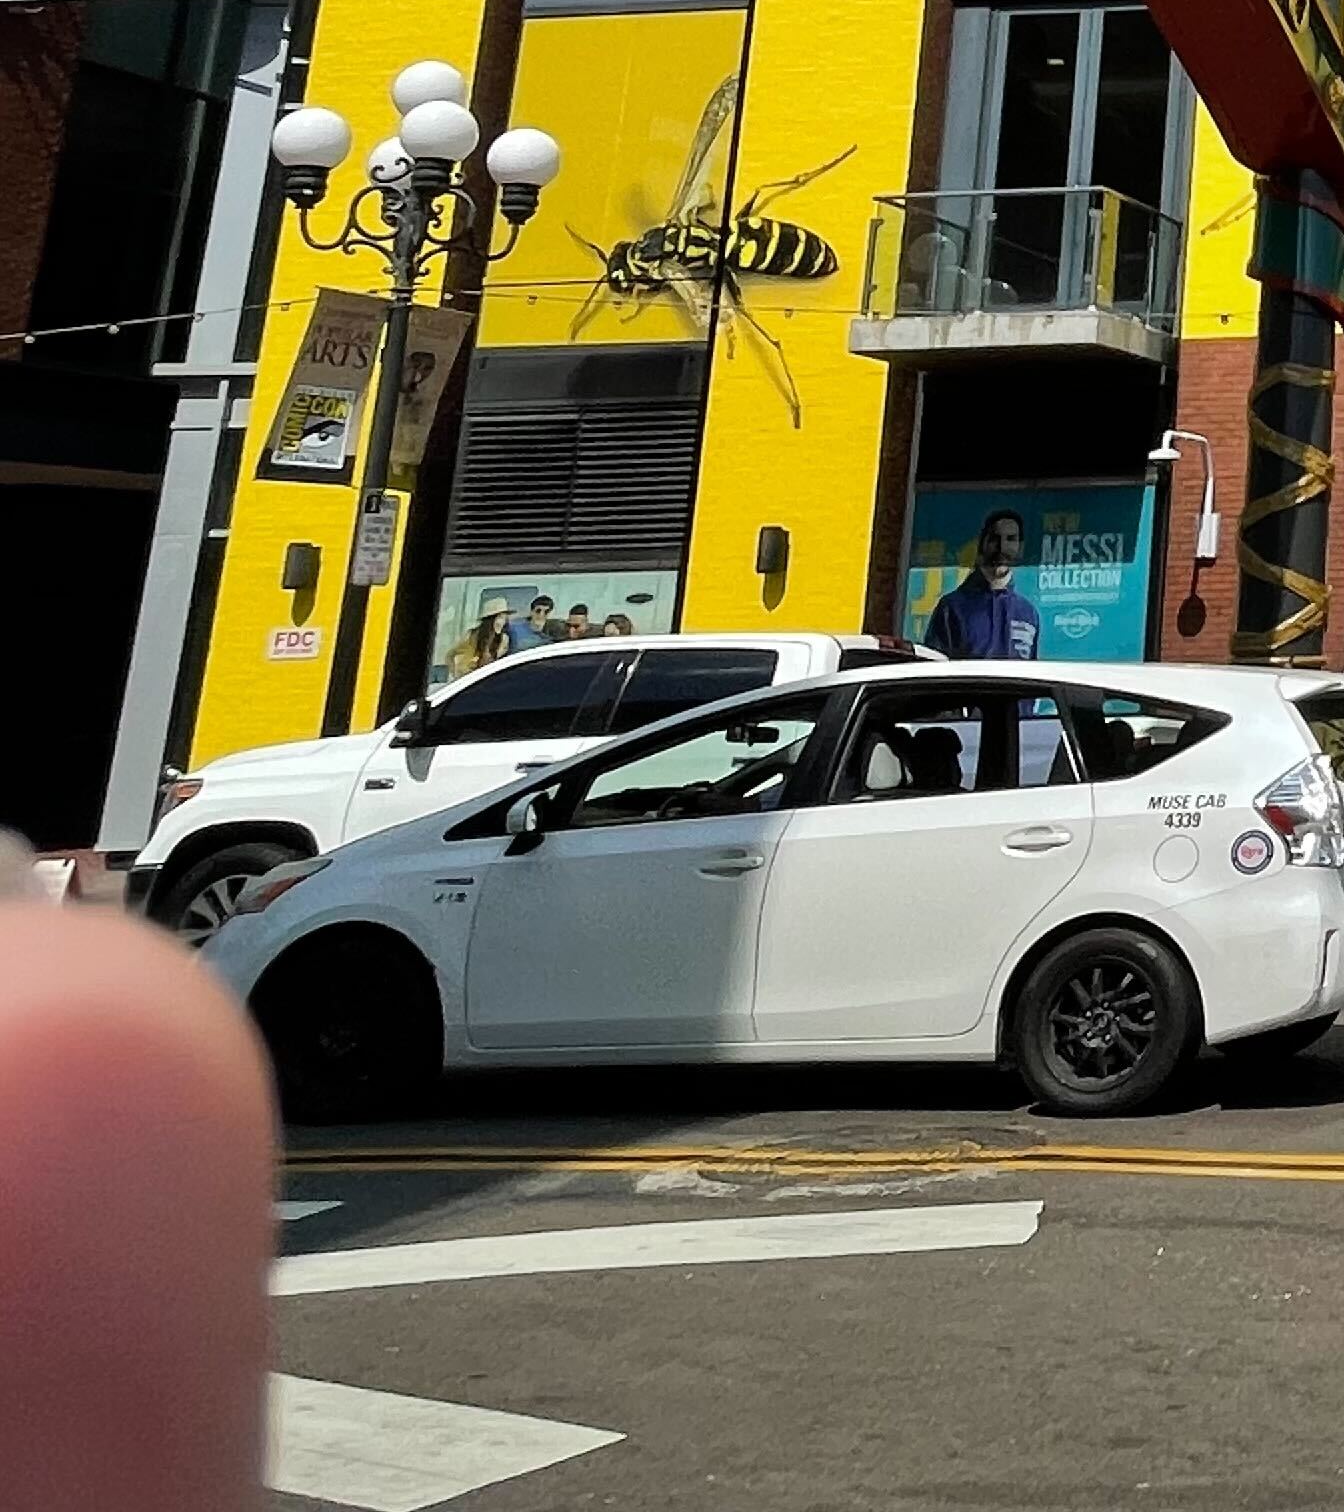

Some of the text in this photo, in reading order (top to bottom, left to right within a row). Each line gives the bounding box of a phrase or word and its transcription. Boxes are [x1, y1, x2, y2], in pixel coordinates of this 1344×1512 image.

[1040, 533, 1124, 570] MESSI
[1039, 570, 1122, 589] COLLECTION
[274, 631, 315, 648] FDC
[1147, 793, 1228, 810] MUSE CAB
[1164, 811, 1202, 828] 4339
